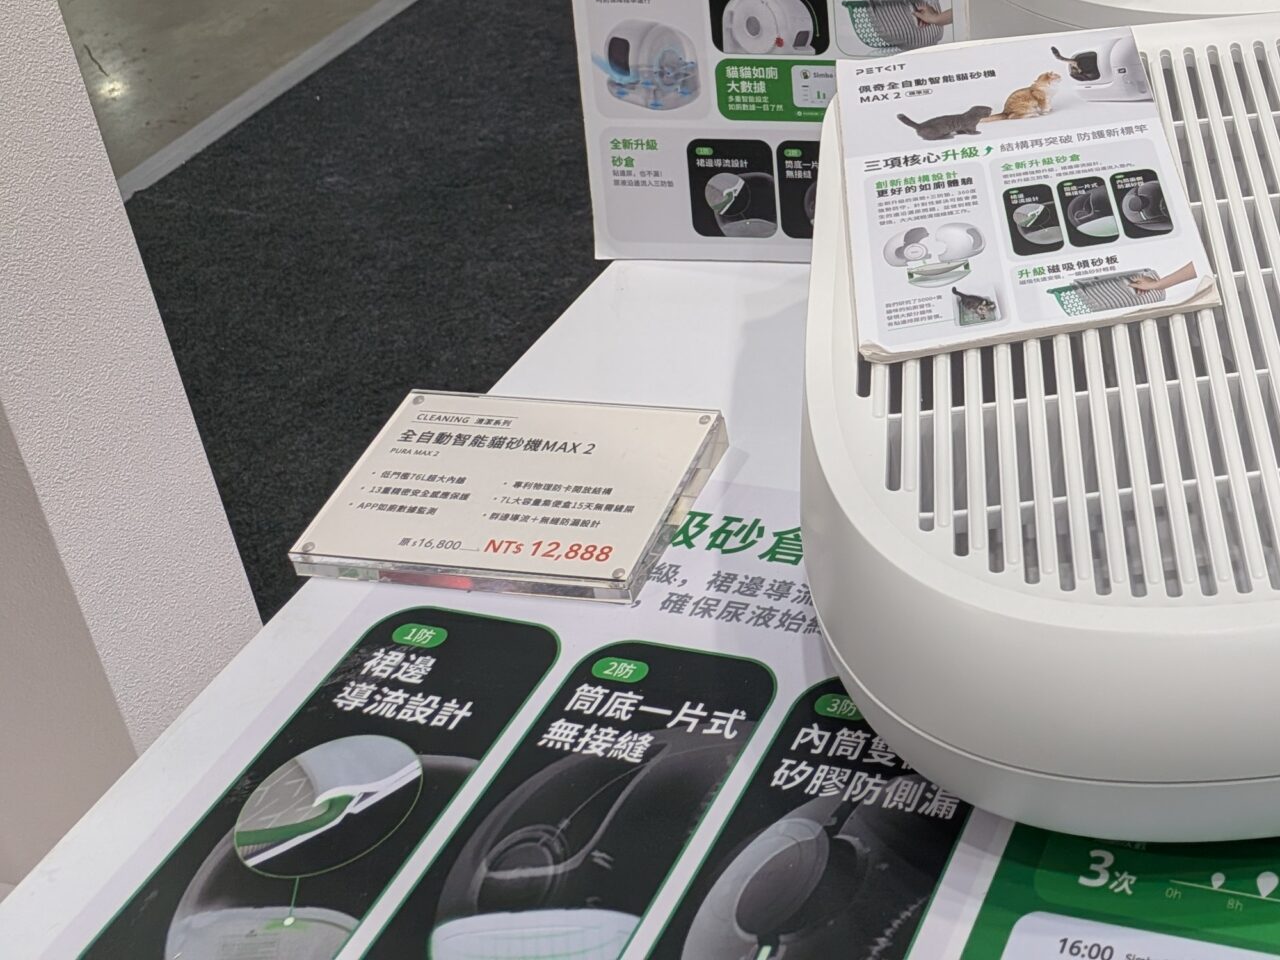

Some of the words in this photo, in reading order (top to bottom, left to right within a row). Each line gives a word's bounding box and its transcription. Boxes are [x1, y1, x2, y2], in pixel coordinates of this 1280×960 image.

[725, 66, 779, 80] 貓貓如廁
[856, 63, 906, 76] PETKIT
[727, 81, 767, 94] 大數據
[859, 93, 889, 104] MAX
[893, 91, 902, 100] 2
[610, 138, 658, 151] 全新升級
[1000, 134, 1074, 153] 結構再突破
[611, 156, 635, 168] 砂倉
[696, 158, 749, 169] 裙邊導流設計
[864, 146, 980, 172] 三項核心升級
[1001, 153, 1081, 171] 全新升級砂倉
[875, 170, 958, 189] 創新結構設計
[876, 177, 973, 198] 更好的如廁體驗
[1018, 254, 1119, 279] 升級磁吸傾砂板
[416, 413, 469, 424] CLEANING
[397, 429, 579, 455] 全自動智能貓砂機MAX
[581, 442, 597, 455] 2
[389, 447, 412, 456] PURA
[413, 448, 433, 457] MAX
[484, 539, 524, 555] NT$
[529, 540, 614, 563] 12,888
[403, 628, 437, 645] 1防
[360, 647, 437, 685] 裙邊
[603, 661, 637, 679] 2防
[332, 680, 474, 731] 導流設計
[563, 683, 747, 740] 筒底一片式
[826, 698, 858, 717] 3防
[538, 717, 655, 764] 無接縫
[790, 722, 912, 770] 內筒雙
[770, 757, 961, 820] 矽膠防側漏
[1164, 887, 1182, 901] 0h
[1226, 898, 1244, 912] 8h
[1057, 937, 1115, 960] 16:00
